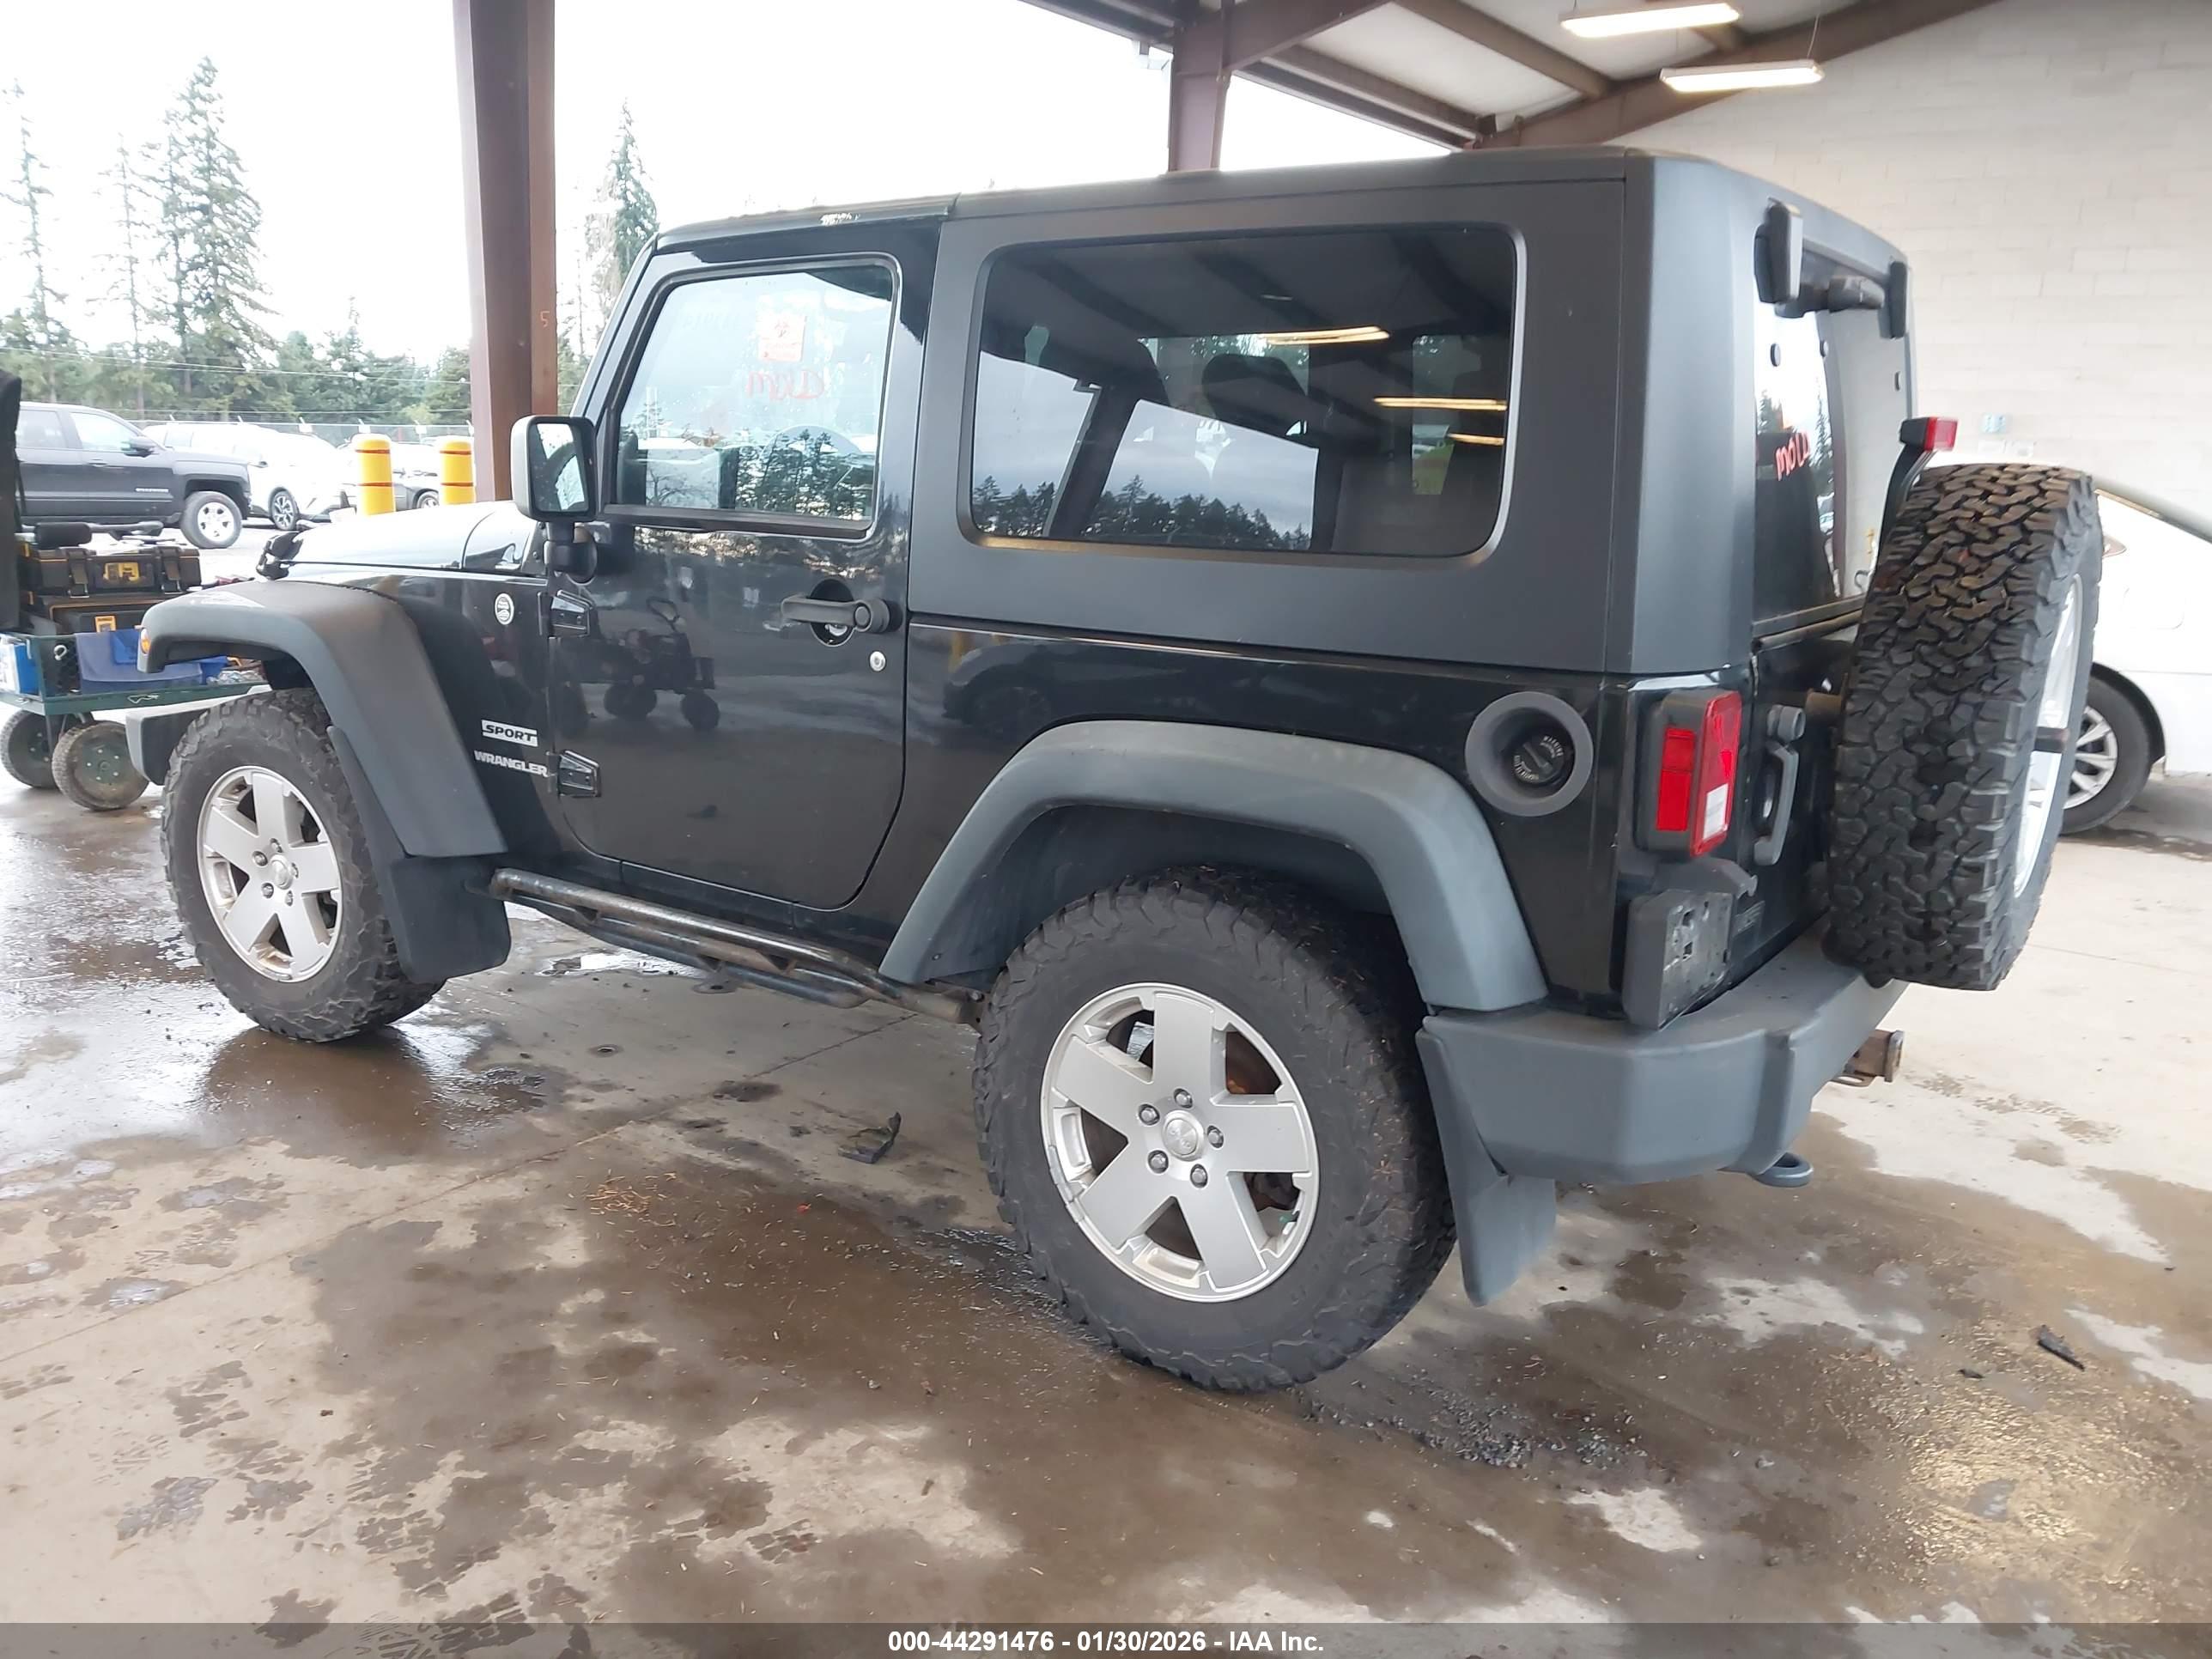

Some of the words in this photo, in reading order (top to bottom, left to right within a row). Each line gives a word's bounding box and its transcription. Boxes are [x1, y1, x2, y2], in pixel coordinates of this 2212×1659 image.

[540, 310, 550, 328] 5
[483, 724, 538, 742] SPORT
[474, 750, 549, 778] WRANGLER
